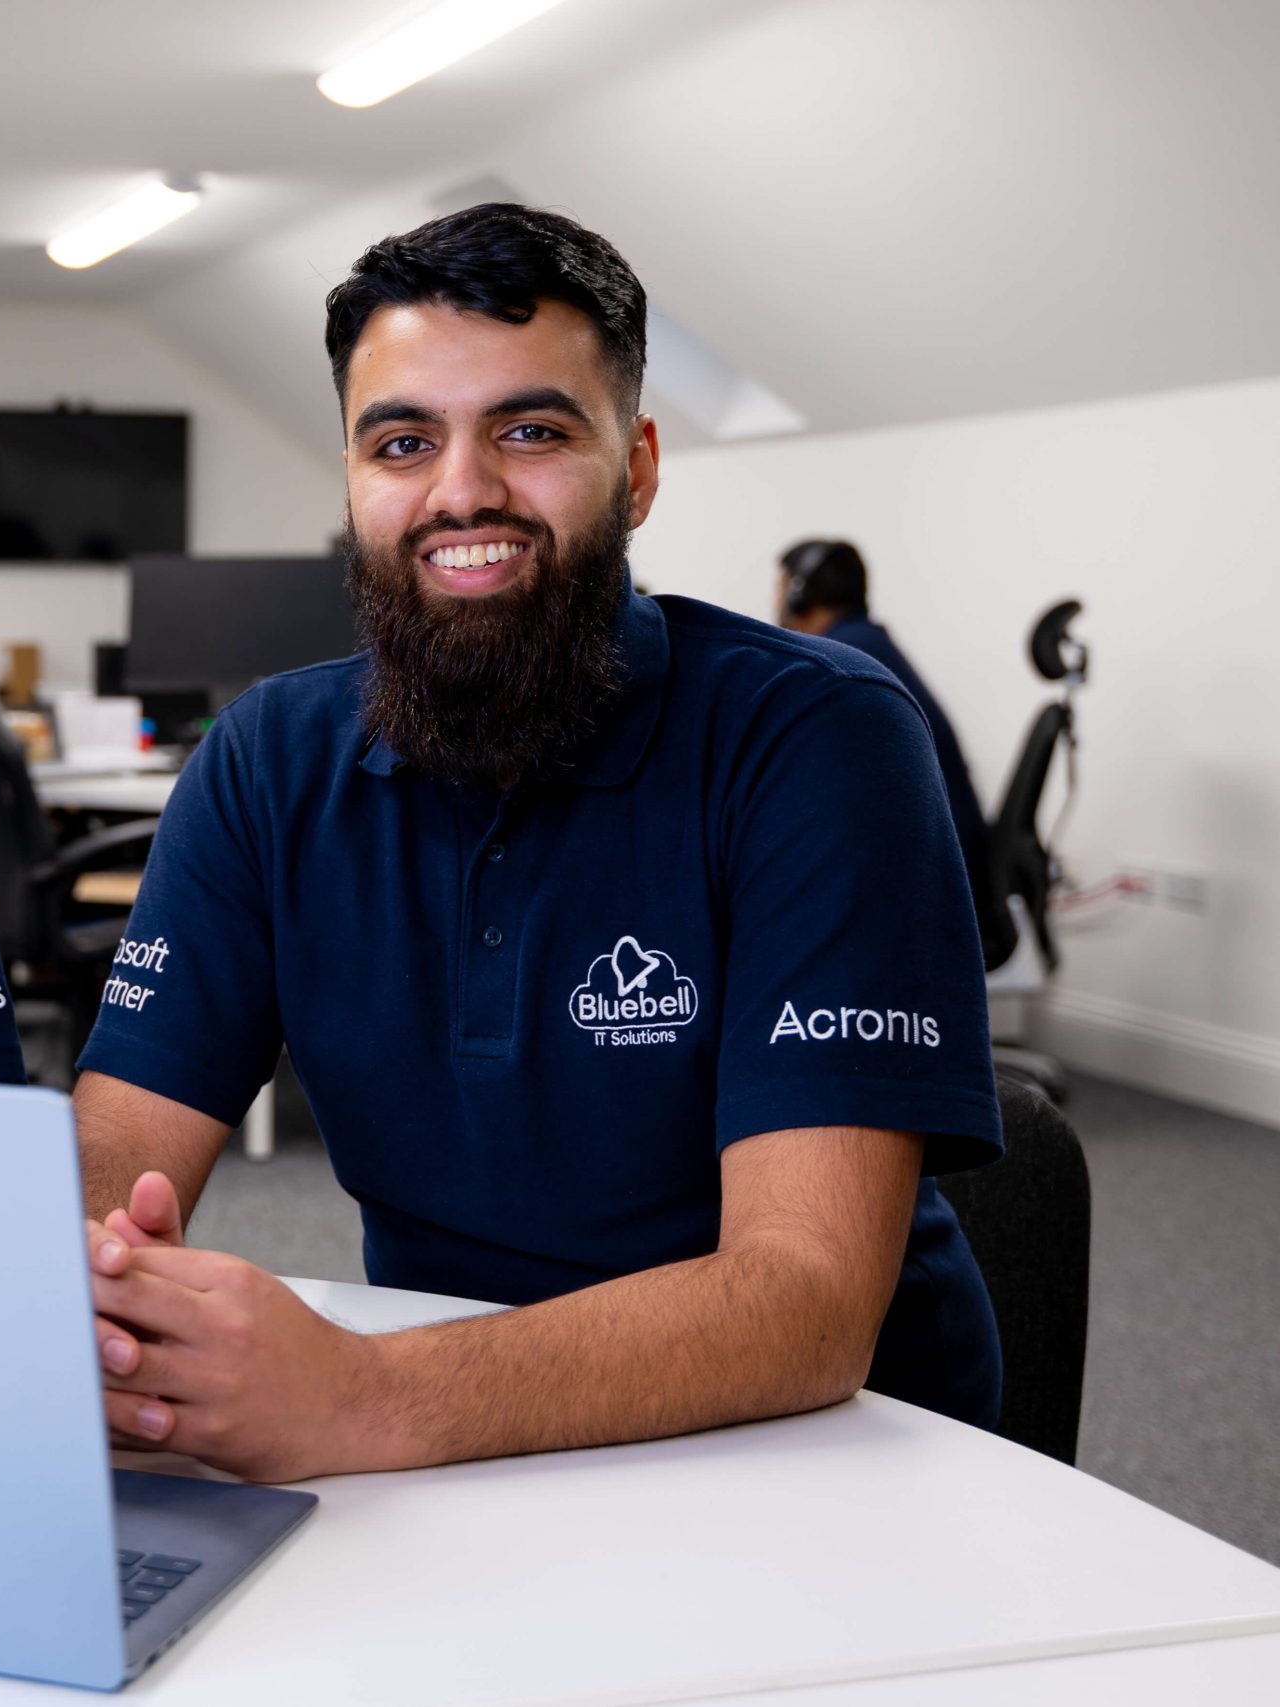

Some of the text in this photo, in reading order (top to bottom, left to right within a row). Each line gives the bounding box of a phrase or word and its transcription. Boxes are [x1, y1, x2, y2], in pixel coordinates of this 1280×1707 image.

[112, 936, 170, 974] osoft
[101, 975, 156, 1012] rtner
[578, 985, 691, 1021] Bluebell
[594, 1028, 677, 1046] IT Solutions
[769, 1000, 941, 1048] Acronis
